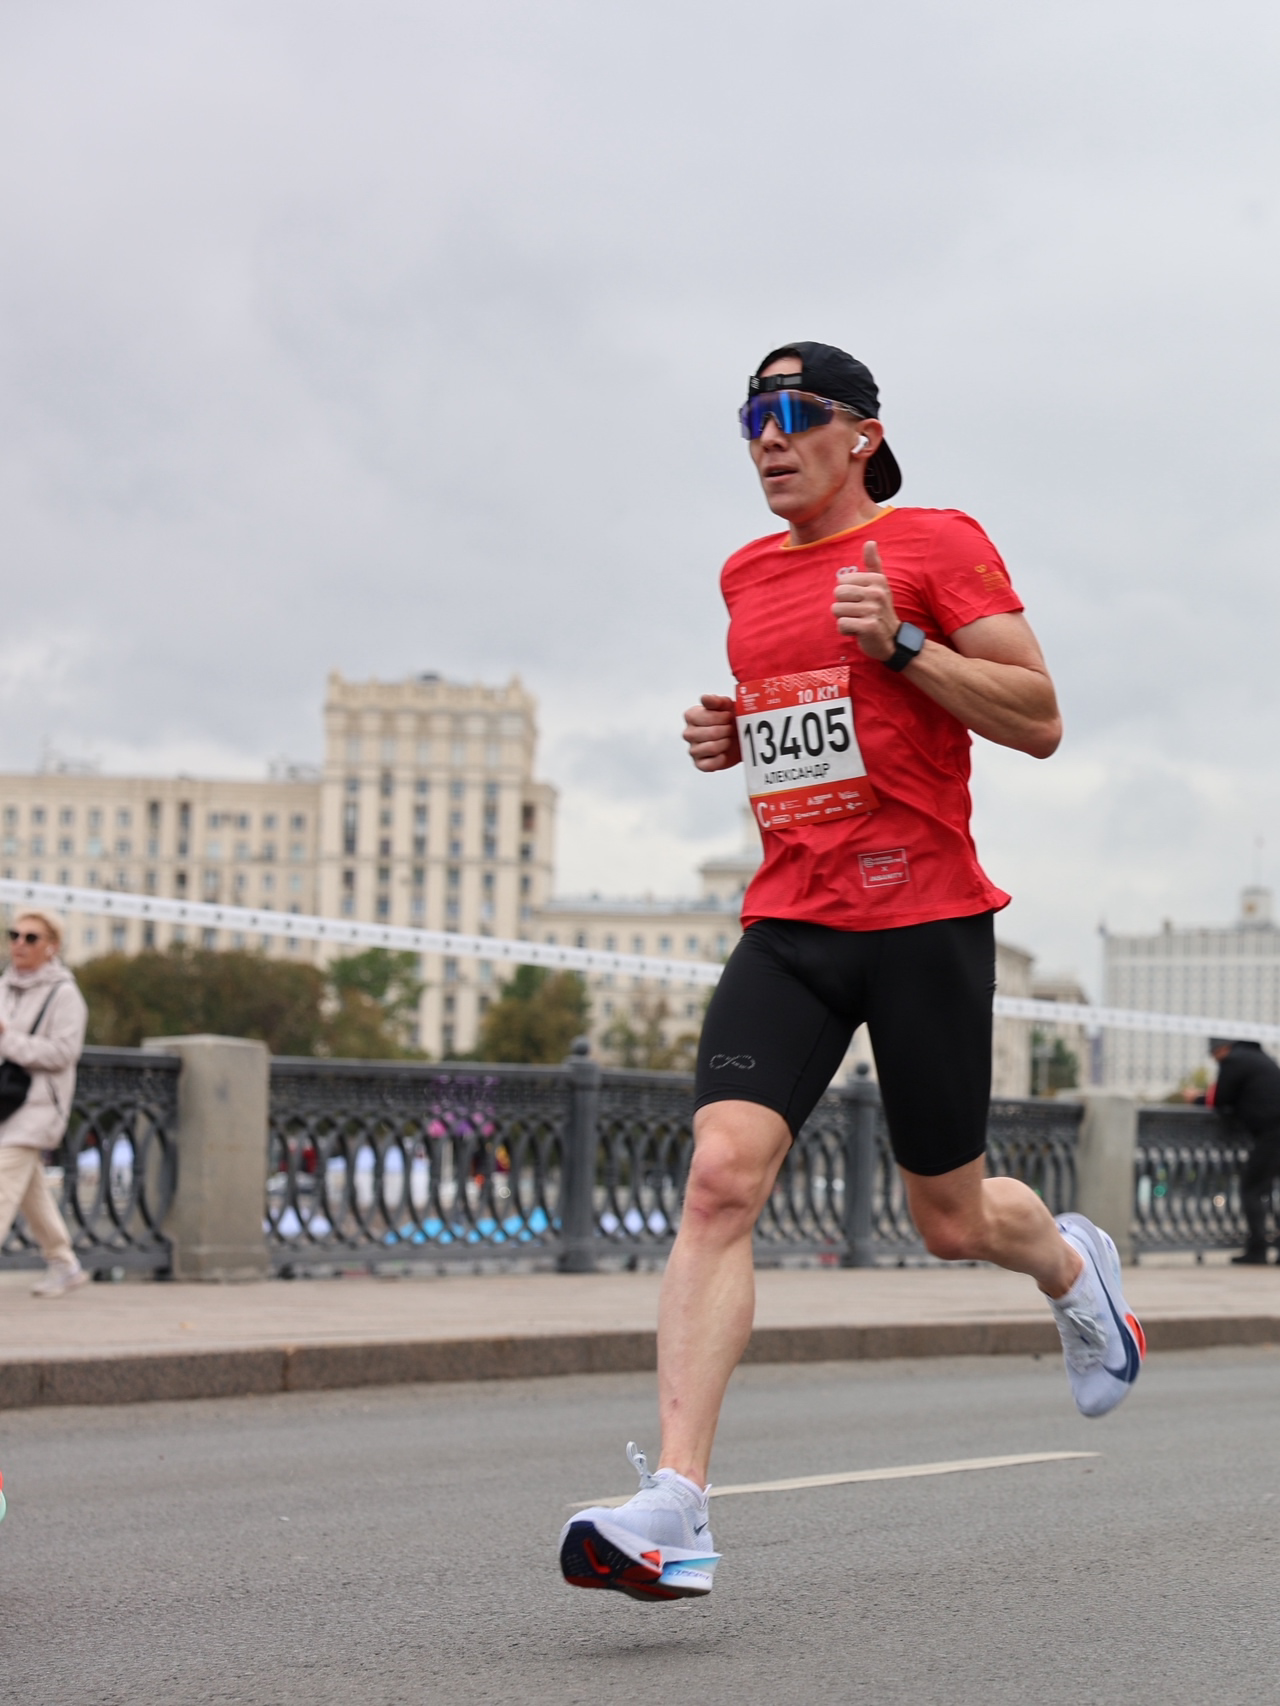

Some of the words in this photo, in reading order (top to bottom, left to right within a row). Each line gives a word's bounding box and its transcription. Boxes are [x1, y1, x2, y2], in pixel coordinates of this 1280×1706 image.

[797, 689, 814, 704] 10
[817, 685, 839, 701] KM
[744, 706, 850, 767] 13405
[764, 763, 830, 785] АЛЕКСАНДР
